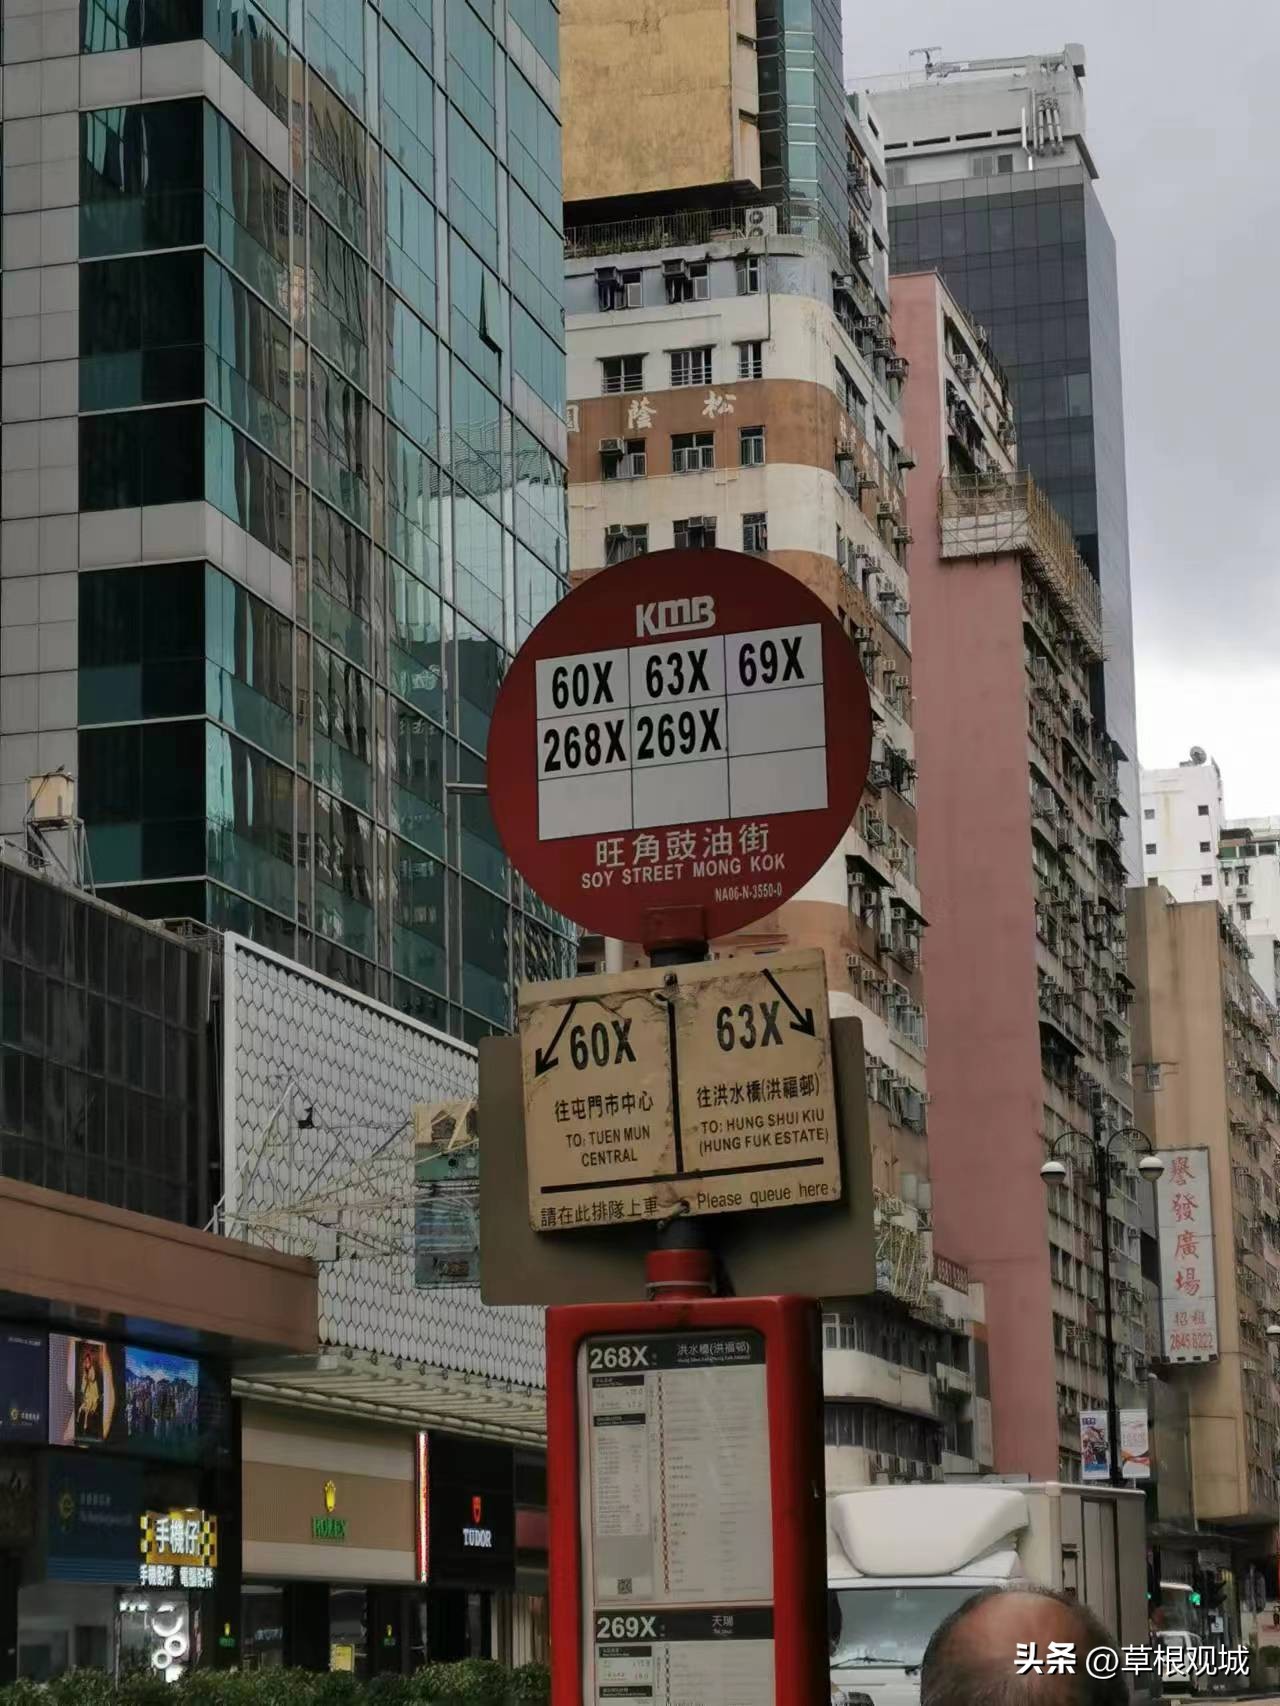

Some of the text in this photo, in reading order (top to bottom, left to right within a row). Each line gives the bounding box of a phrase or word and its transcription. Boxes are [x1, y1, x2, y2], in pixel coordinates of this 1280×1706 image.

[635, 595, 716, 638] KMB
[645, 648, 710, 698] 63X
[738, 636, 805, 687] 69X
[552, 661, 614, 709] 60X
[543, 719, 627, 772] 268X
[637, 708, 722, 760] 269X
[595, 822, 769, 868] 旺角豉油街
[582, 853, 785, 889] SOY STREET MONG KOK
[716, 1000, 783, 1051] 63X
[569, 1018, 637, 1070] 60X
[554, 1090, 654, 1123] 往屯門市中心
[701, 1108, 825, 1134] TO: HUNG SHUI KIU
[565, 1125, 651, 1148] TO: TUEN MUN
[699, 1127, 829, 1157] (HUNG FUK ESTATE)
[581, 1149, 638, 1167] CENTRAL
[540, 1196, 658, 1227] 請在此排隊上車
[697, 1181, 830, 1211] Please queue here
[590, 1345, 649, 1369] 268X
[463, 1528, 492, 1548] TUDOR
[597, 1616, 657, 1638] 269X
